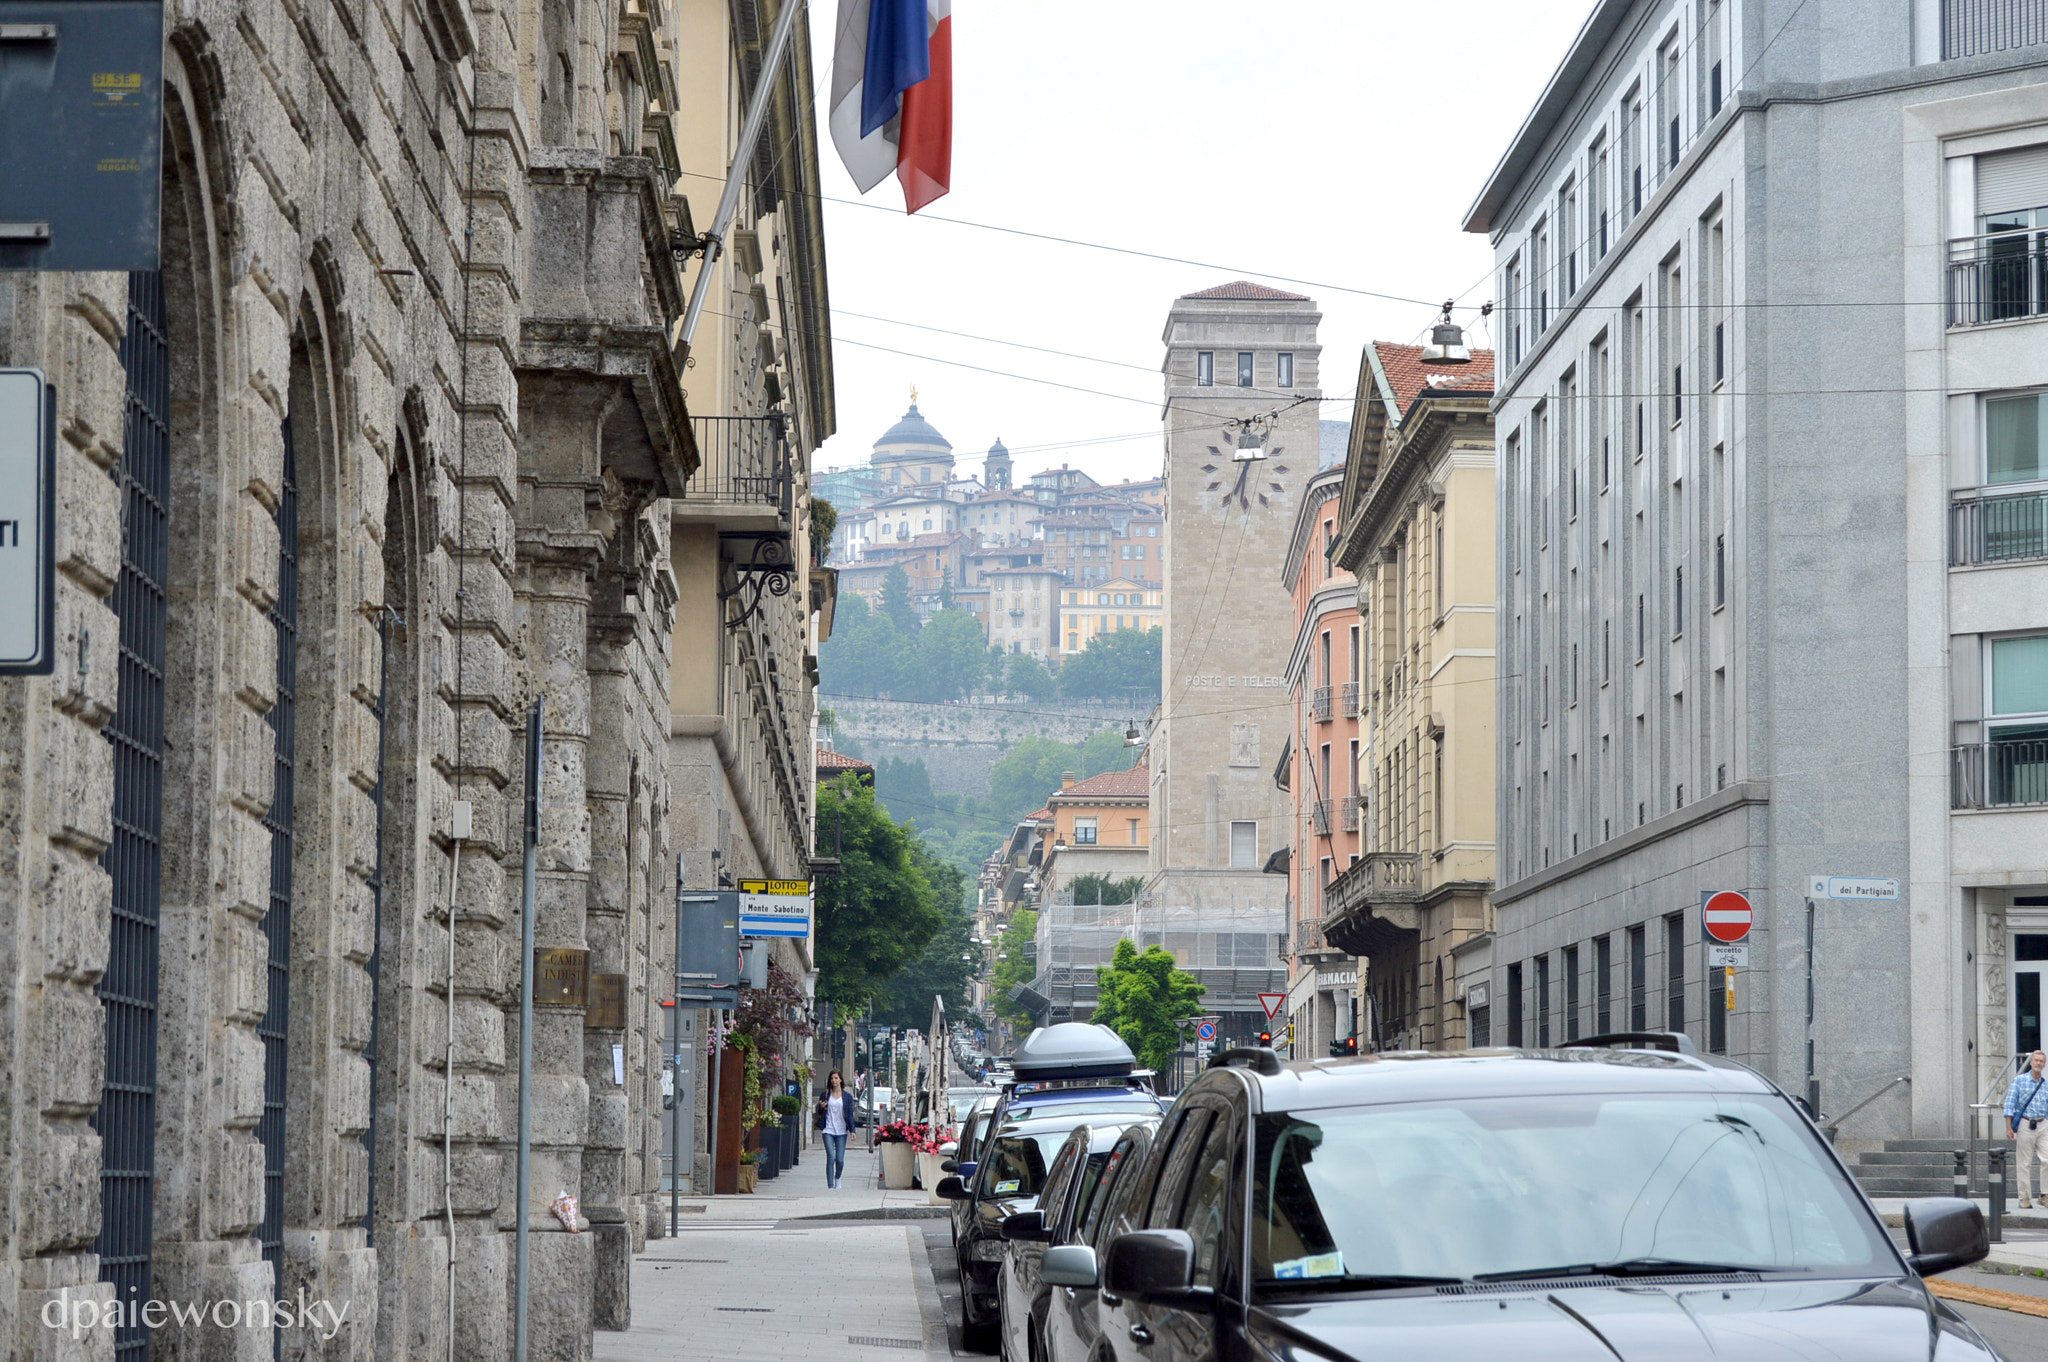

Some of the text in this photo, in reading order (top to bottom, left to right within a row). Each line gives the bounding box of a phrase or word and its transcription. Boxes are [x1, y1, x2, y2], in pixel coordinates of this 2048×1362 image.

[1185, 675, 1222, 687] POSTE
[1228, 675, 1237, 687] E
[770, 882, 797, 890] LOTTO
[1840, 886, 1894, 896] dei Partigiani
[748, 904, 804, 914] Monte Sabotino
